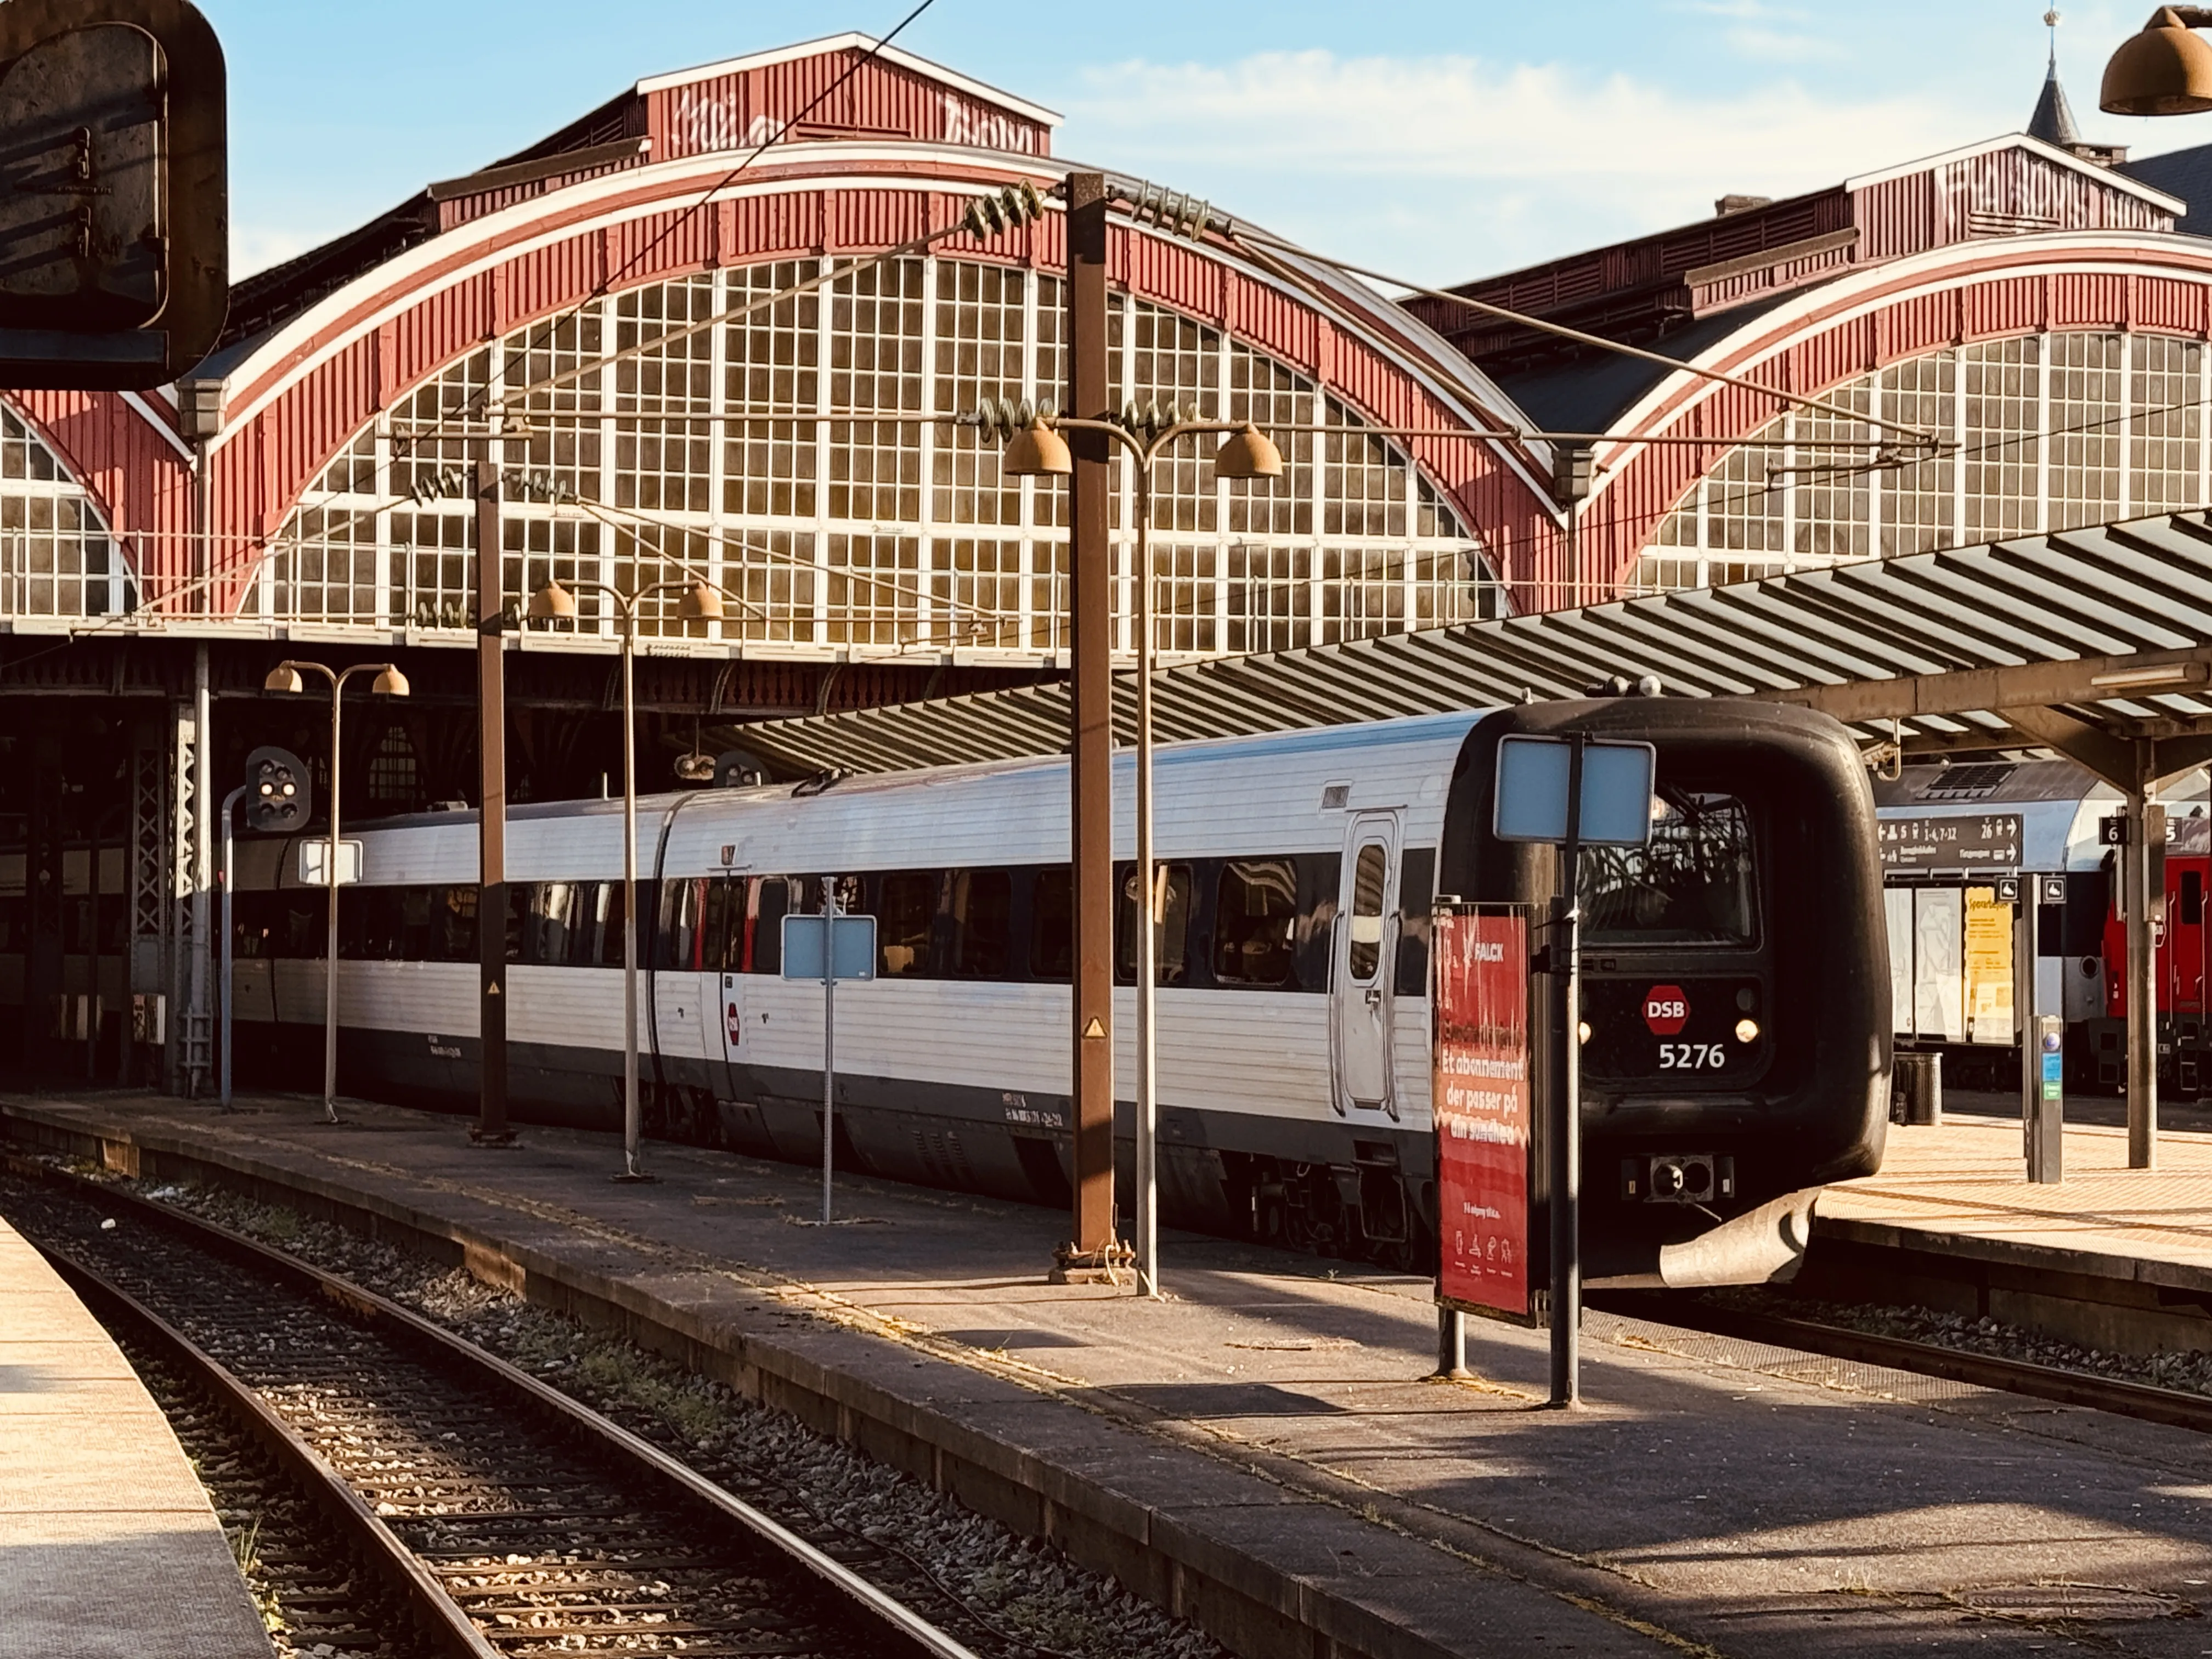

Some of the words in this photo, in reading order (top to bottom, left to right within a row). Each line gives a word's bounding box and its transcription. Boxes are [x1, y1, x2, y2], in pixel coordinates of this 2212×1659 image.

[2108, 826, 2119, 841] 6
[2166, 826, 2176, 842] 5
[1475, 943, 1504, 962] FALCK
[1648, 1001, 1685, 1018] DSB
[1442, 1049, 1454, 1074] Et
[1456, 1050, 1524, 1081] abonnement
[1660, 1043, 1725, 1069] 5276
[1447, 1080, 1464, 1107] der
[1466, 1089, 1502, 1114] passer
[1504, 1084, 1518, 1119] på
[1451, 1114, 1467, 1139] din
